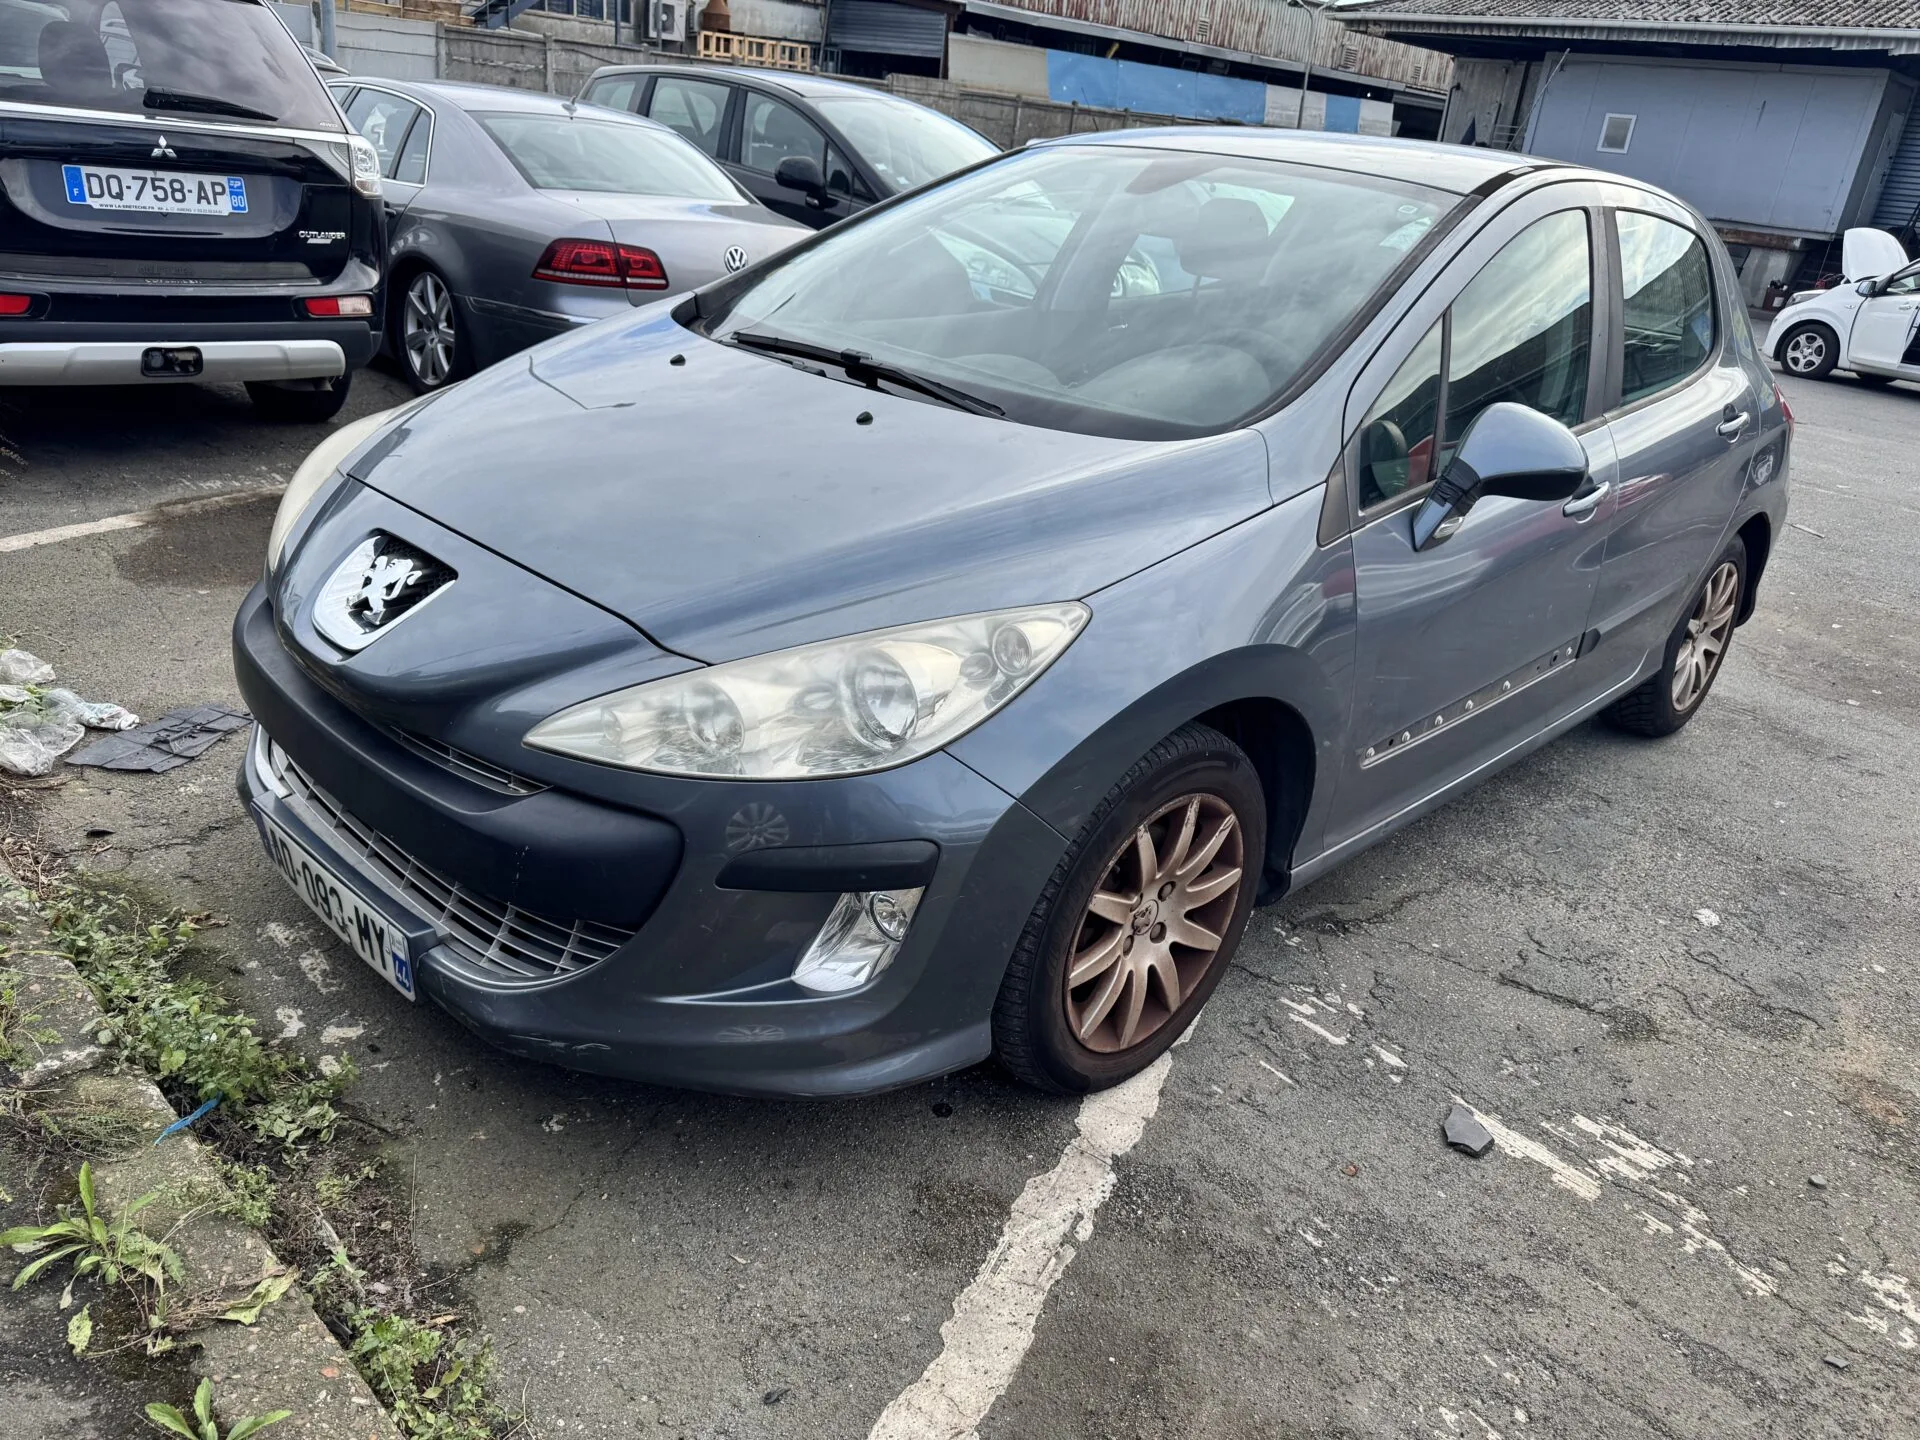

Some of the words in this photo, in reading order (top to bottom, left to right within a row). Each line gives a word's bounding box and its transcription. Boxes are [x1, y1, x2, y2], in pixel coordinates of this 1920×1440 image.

[73, 188, 80, 197] F
[85, 172, 227, 206] DQ-758-AP
[231, 195, 245, 208] 80
[298, 230, 346, 240] OUTLANDER
[395, 959, 410, 988] 44
